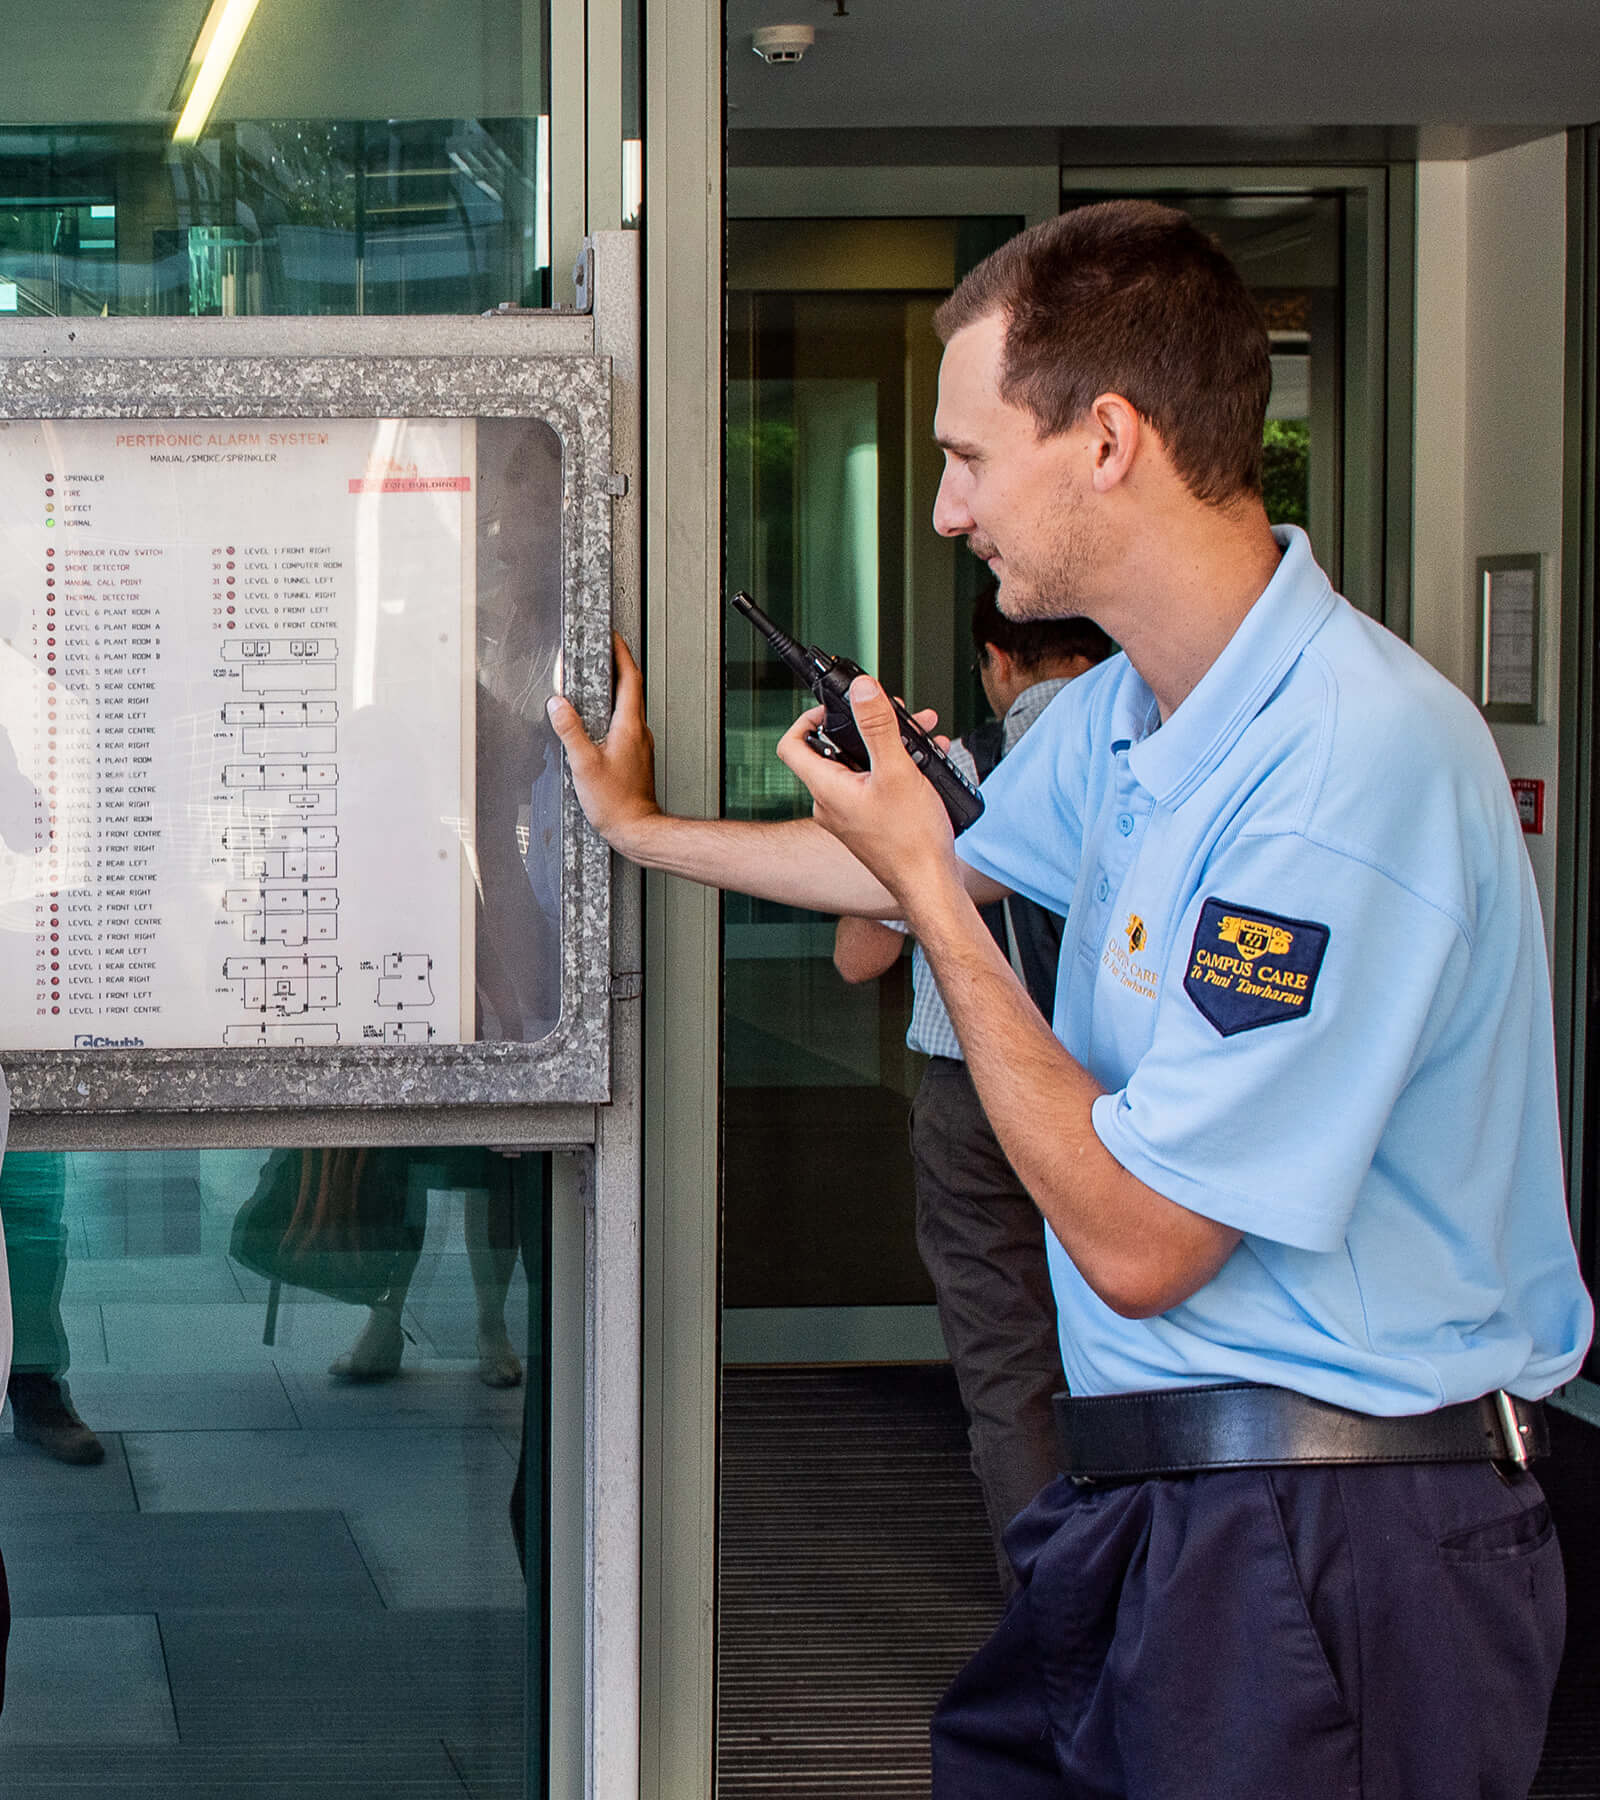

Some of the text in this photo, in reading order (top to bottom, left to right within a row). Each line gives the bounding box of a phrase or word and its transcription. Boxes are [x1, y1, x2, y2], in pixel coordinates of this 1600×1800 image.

[115, 433, 330, 447] PERTRONIC ALARM SYSTEM
[150, 454, 277, 463] MANUAL/SMOKE/SPRINKLER
[64, 474, 104, 482] SPRINKLER
[64, 504, 91, 512] DEFECT
[109, 549, 130, 557] FLOW
[134, 548, 163, 556] SWITCH
[244, 547, 268, 555] LEVEL
[64, 564, 88, 572] SMOKE
[244, 562, 269, 570] LEVEL
[323, 561, 343, 569] ROOM
[96, 579, 116, 587] CALL
[120, 578, 142, 586] POINT
[244, 577, 269, 585] LEVEL
[102, 593, 140, 601] DETECTOR
[244, 592, 270, 600] LEVEL
[131, 608, 151, 616] ROOM
[310, 606, 328, 614] LEFT
[310, 621, 337, 629] CENTRE
[65, 668, 90, 676] LEVEL
[127, 667, 146, 675] LEFT
[127, 682, 155, 690] CENTRE
[67, 889, 92, 897] LEVEL
[67, 904, 92, 912] LEVEL
[134, 903, 152, 911] LEFT
[68, 919, 93, 927] LEVEL
[68, 948, 93, 956] LEVEL
[128, 947, 147, 955] LEFT
[68, 963, 93, 971] LEVEL
[1196, 950, 1308, 990] CAMPUS CARE
[1190, 965, 1304, 1006] Te Puni Tawharau
[69, 992, 94, 1000] LEVEL
[133, 991, 152, 999] LEFT
[69, 1007, 94, 1015] LEVEL
[106, 1006, 129, 1014] FRONT
[93, 1037, 144, 1047] Chubb
